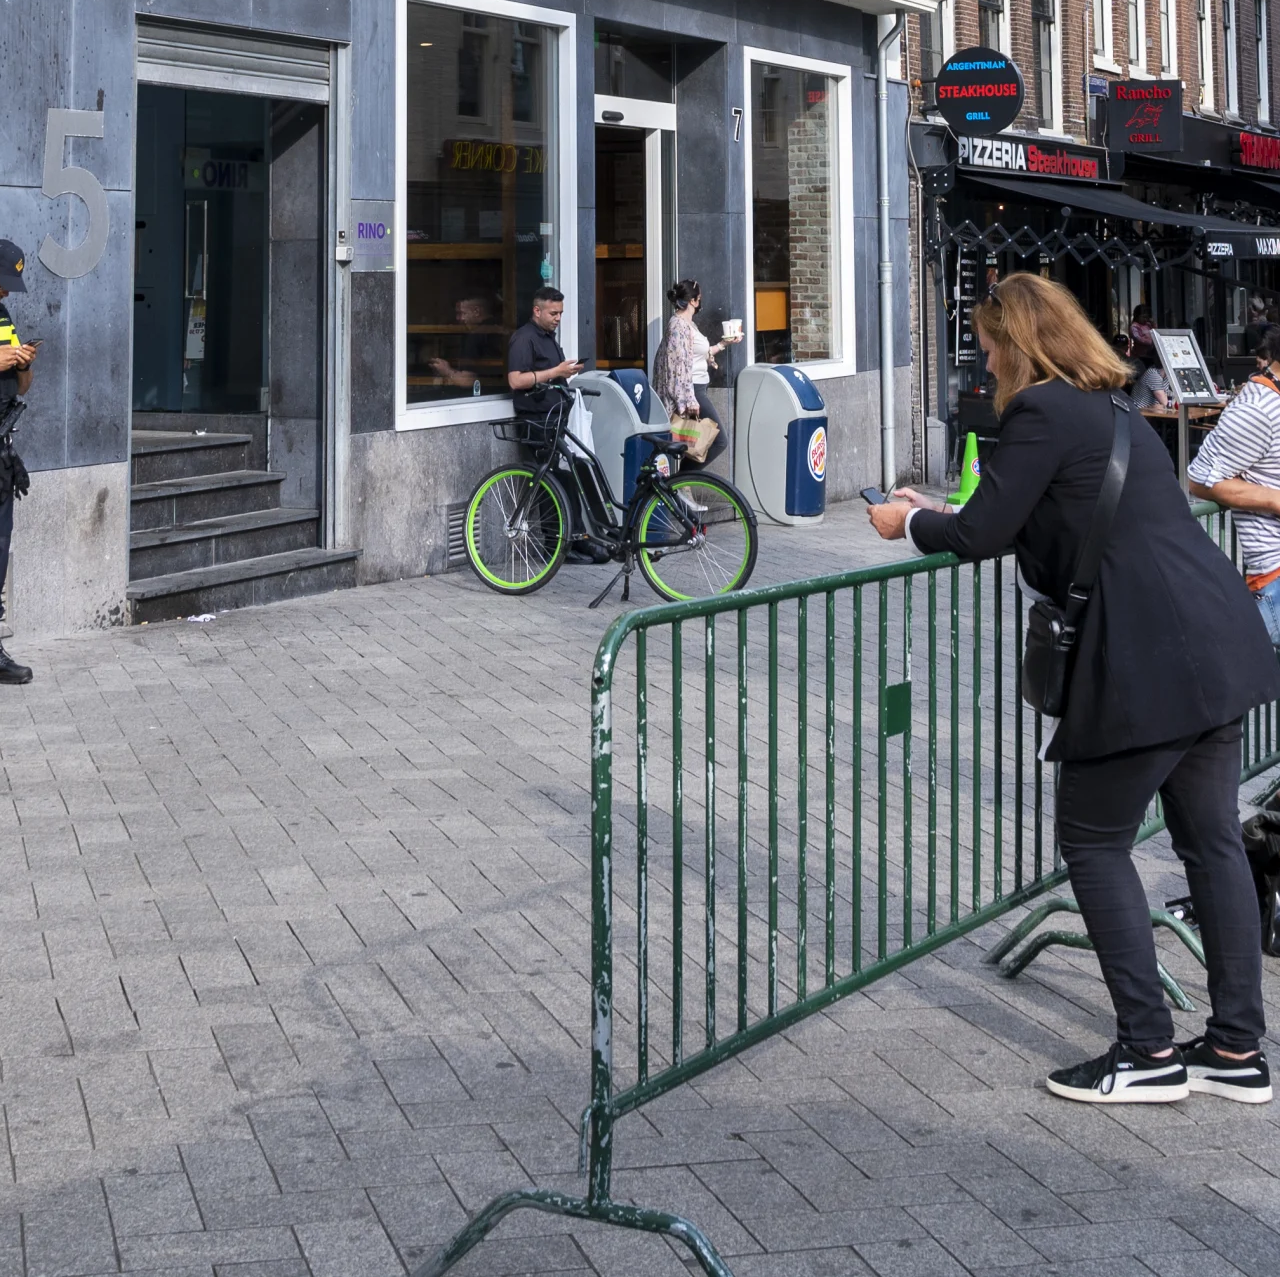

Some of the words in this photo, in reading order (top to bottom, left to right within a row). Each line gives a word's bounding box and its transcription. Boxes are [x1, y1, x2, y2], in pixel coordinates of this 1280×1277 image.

[946, 60, 1006, 71] ARGENTINIAN
[939, 83, 1017, 99] STEAKHOUSE
[1116, 85, 1172, 100] Rancho
[966, 111, 991, 121] GRILL
[732, 107, 743, 142] 7
[1129, 133, 1163, 144] GRILL
[958, 136, 1027, 171] PIZZERIA
[1028, 145, 1099, 178] Steakhouse
[38, 108, 110, 279] 5
[358, 223, 386, 239] RINO
